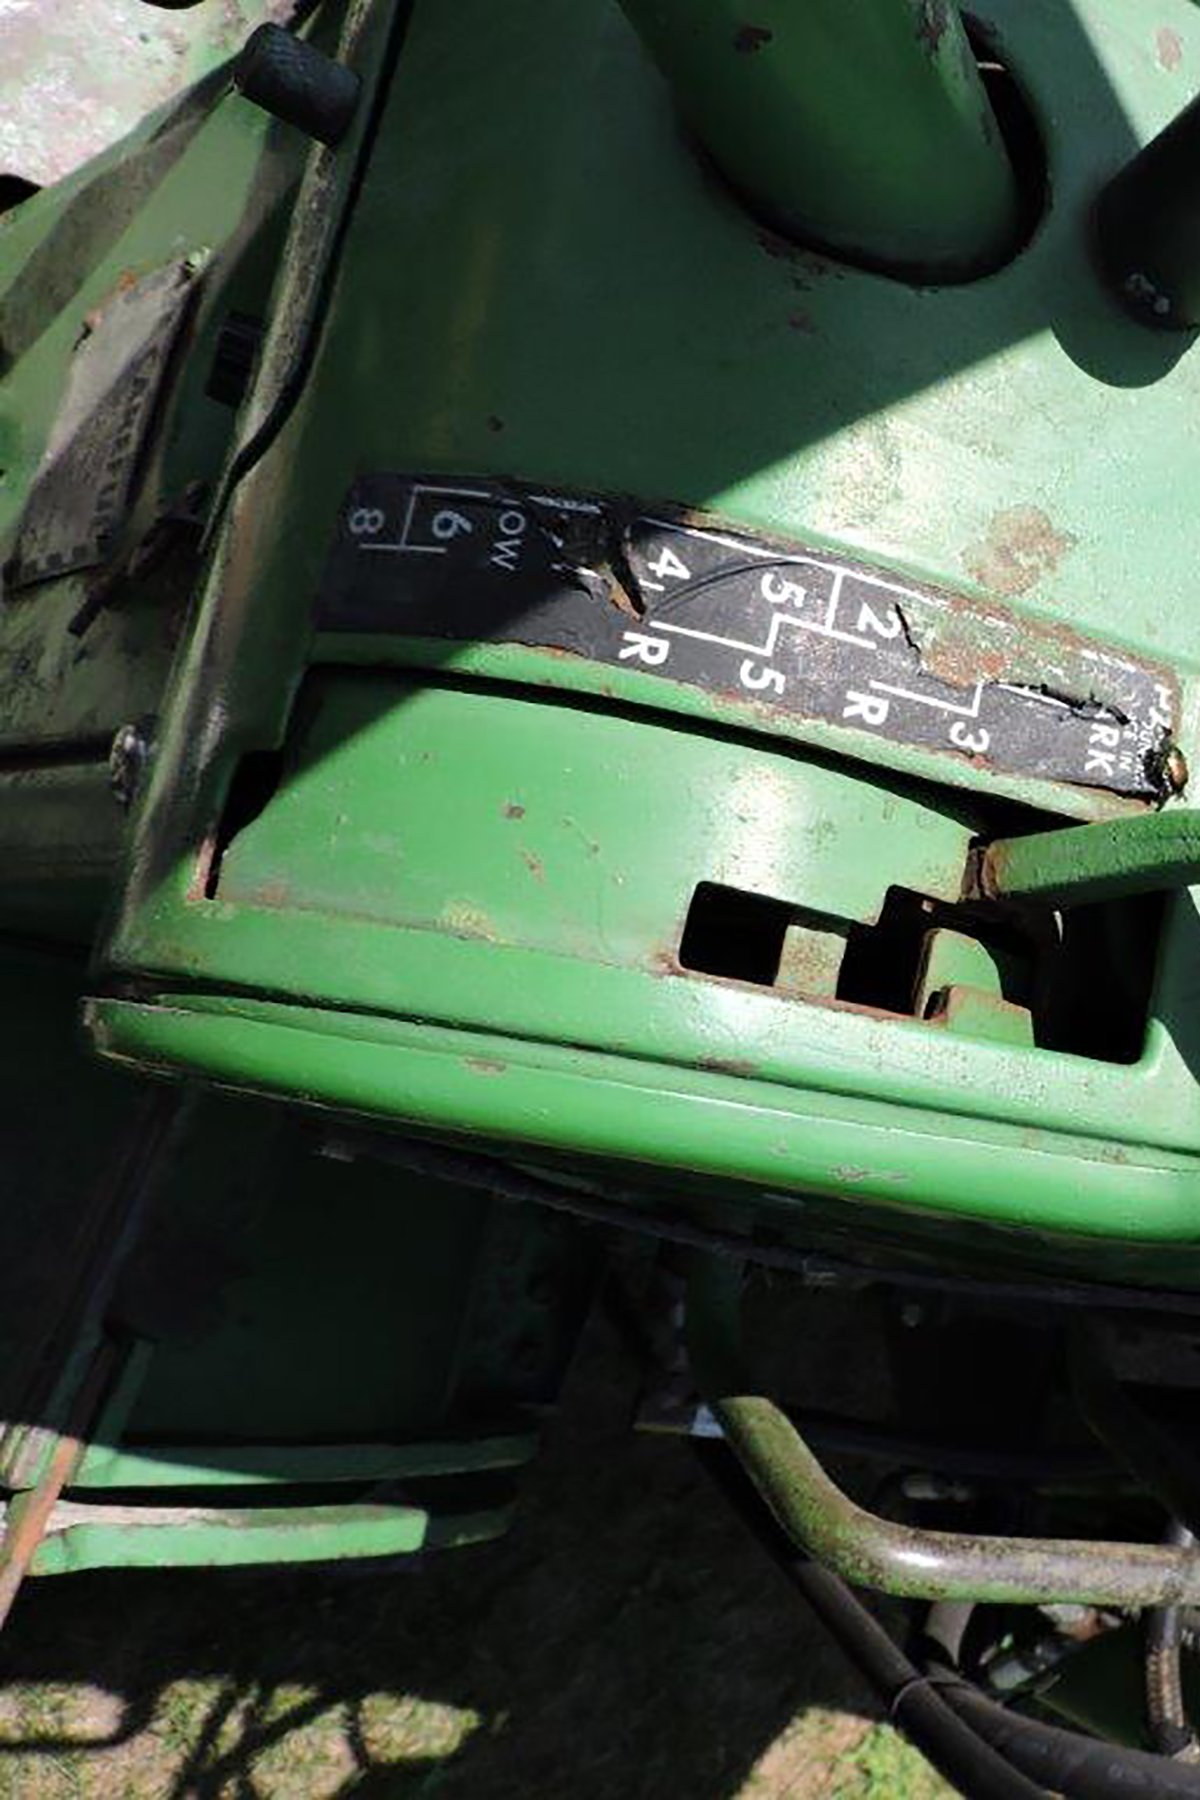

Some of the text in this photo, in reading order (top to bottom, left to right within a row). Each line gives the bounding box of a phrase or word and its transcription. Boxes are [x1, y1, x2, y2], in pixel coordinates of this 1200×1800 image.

[350, 508, 385, 534] 8
[431, 509, 472, 539] 6
[648, 547, 691, 580] 4
[761, 573, 806, 607] 5
[856, 602, 902, 639] 2
[618, 631, 670, 665] R
[739, 659, 786, 695] 5
[842, 690, 889, 726] R
[950, 721, 990, 752] 3
